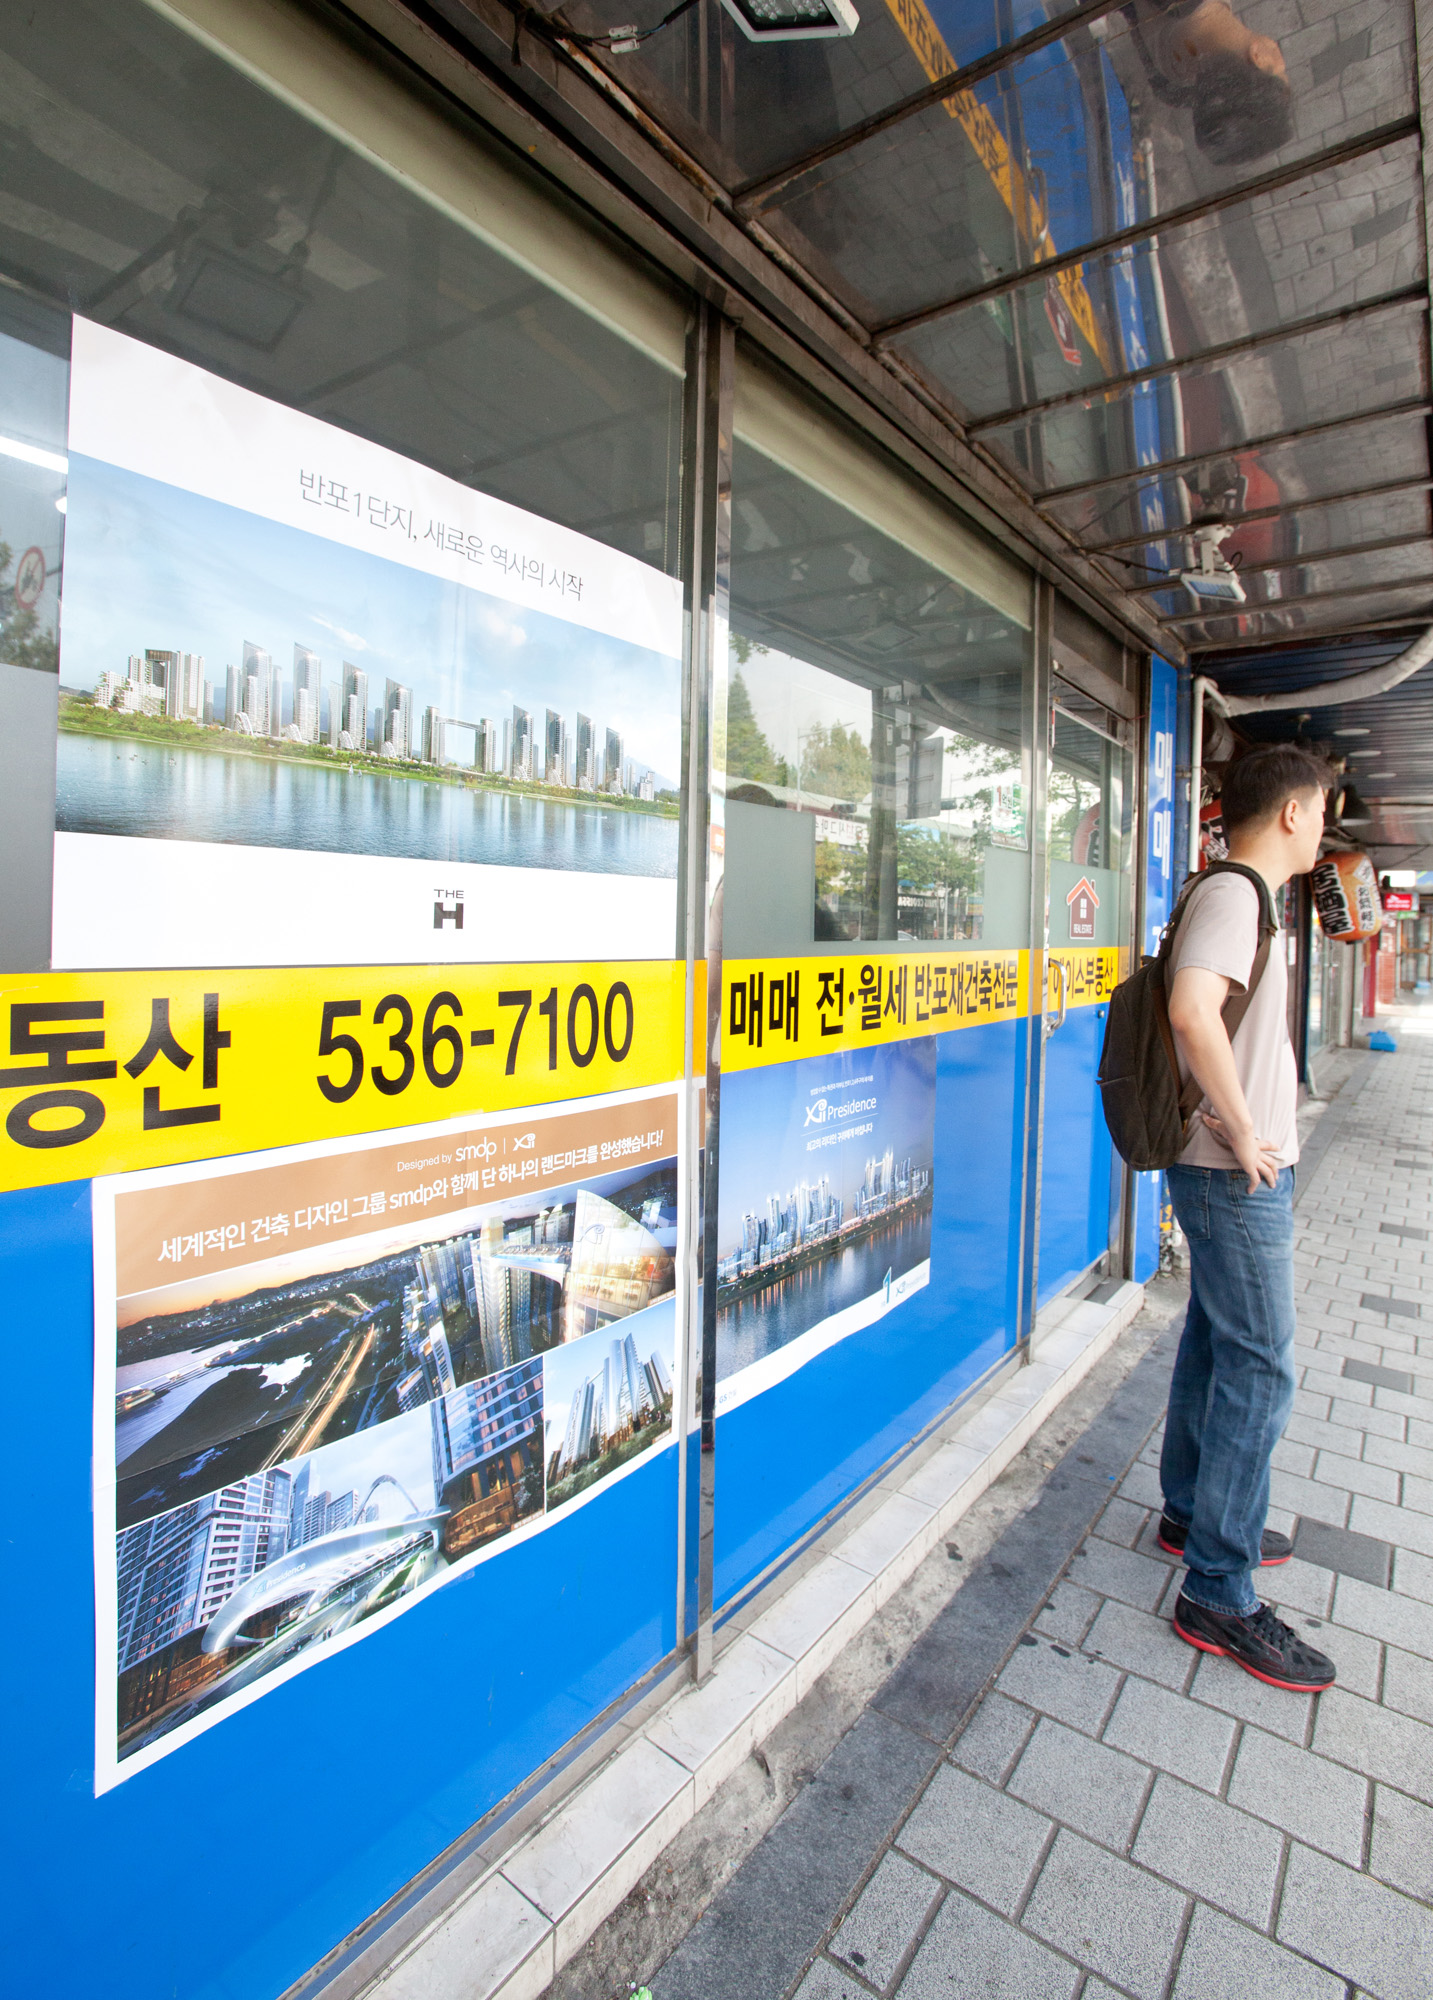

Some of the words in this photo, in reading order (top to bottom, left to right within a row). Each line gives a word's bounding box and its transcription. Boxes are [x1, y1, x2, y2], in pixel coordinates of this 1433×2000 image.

[299, 468, 418, 542] 반포1단지,
[423, 519, 485, 565] 새로운
[490, 544, 544, 588] 역사의
[549, 568, 584, 602] 시작
[433, 888, 465, 899] THE
[433, 902, 464, 929] H
[730, 970, 800, 1048] 매매
[914, 960, 1018, 1022] 반포재건축전문
[0, 992, 232, 1149] 동산
[317, 980, 634, 1104] 536-7100
[828, 1097, 877, 1120] Presidence
[397, 1155, 440, 1172] Designed
[442, 1153, 452, 1165] by
[455, 1136, 497, 1162] smdp
[158, 1222, 246, 1263] 세계적인
[250, 1213, 291, 1243] 건축
[294, 1199, 348, 1231] 디자인
[351, 1191, 387, 1217] 그룹
[389, 1178, 448, 1210] smdp와
[451, 1170, 479, 1197] 함께
[481, 1167, 496, 1188] 단
[498, 1157, 539, 1184] 하나의
[541, 1145, 598, 1175] 랜드마크를
[600, 1129, 664, 1160] 완성했습니다!
